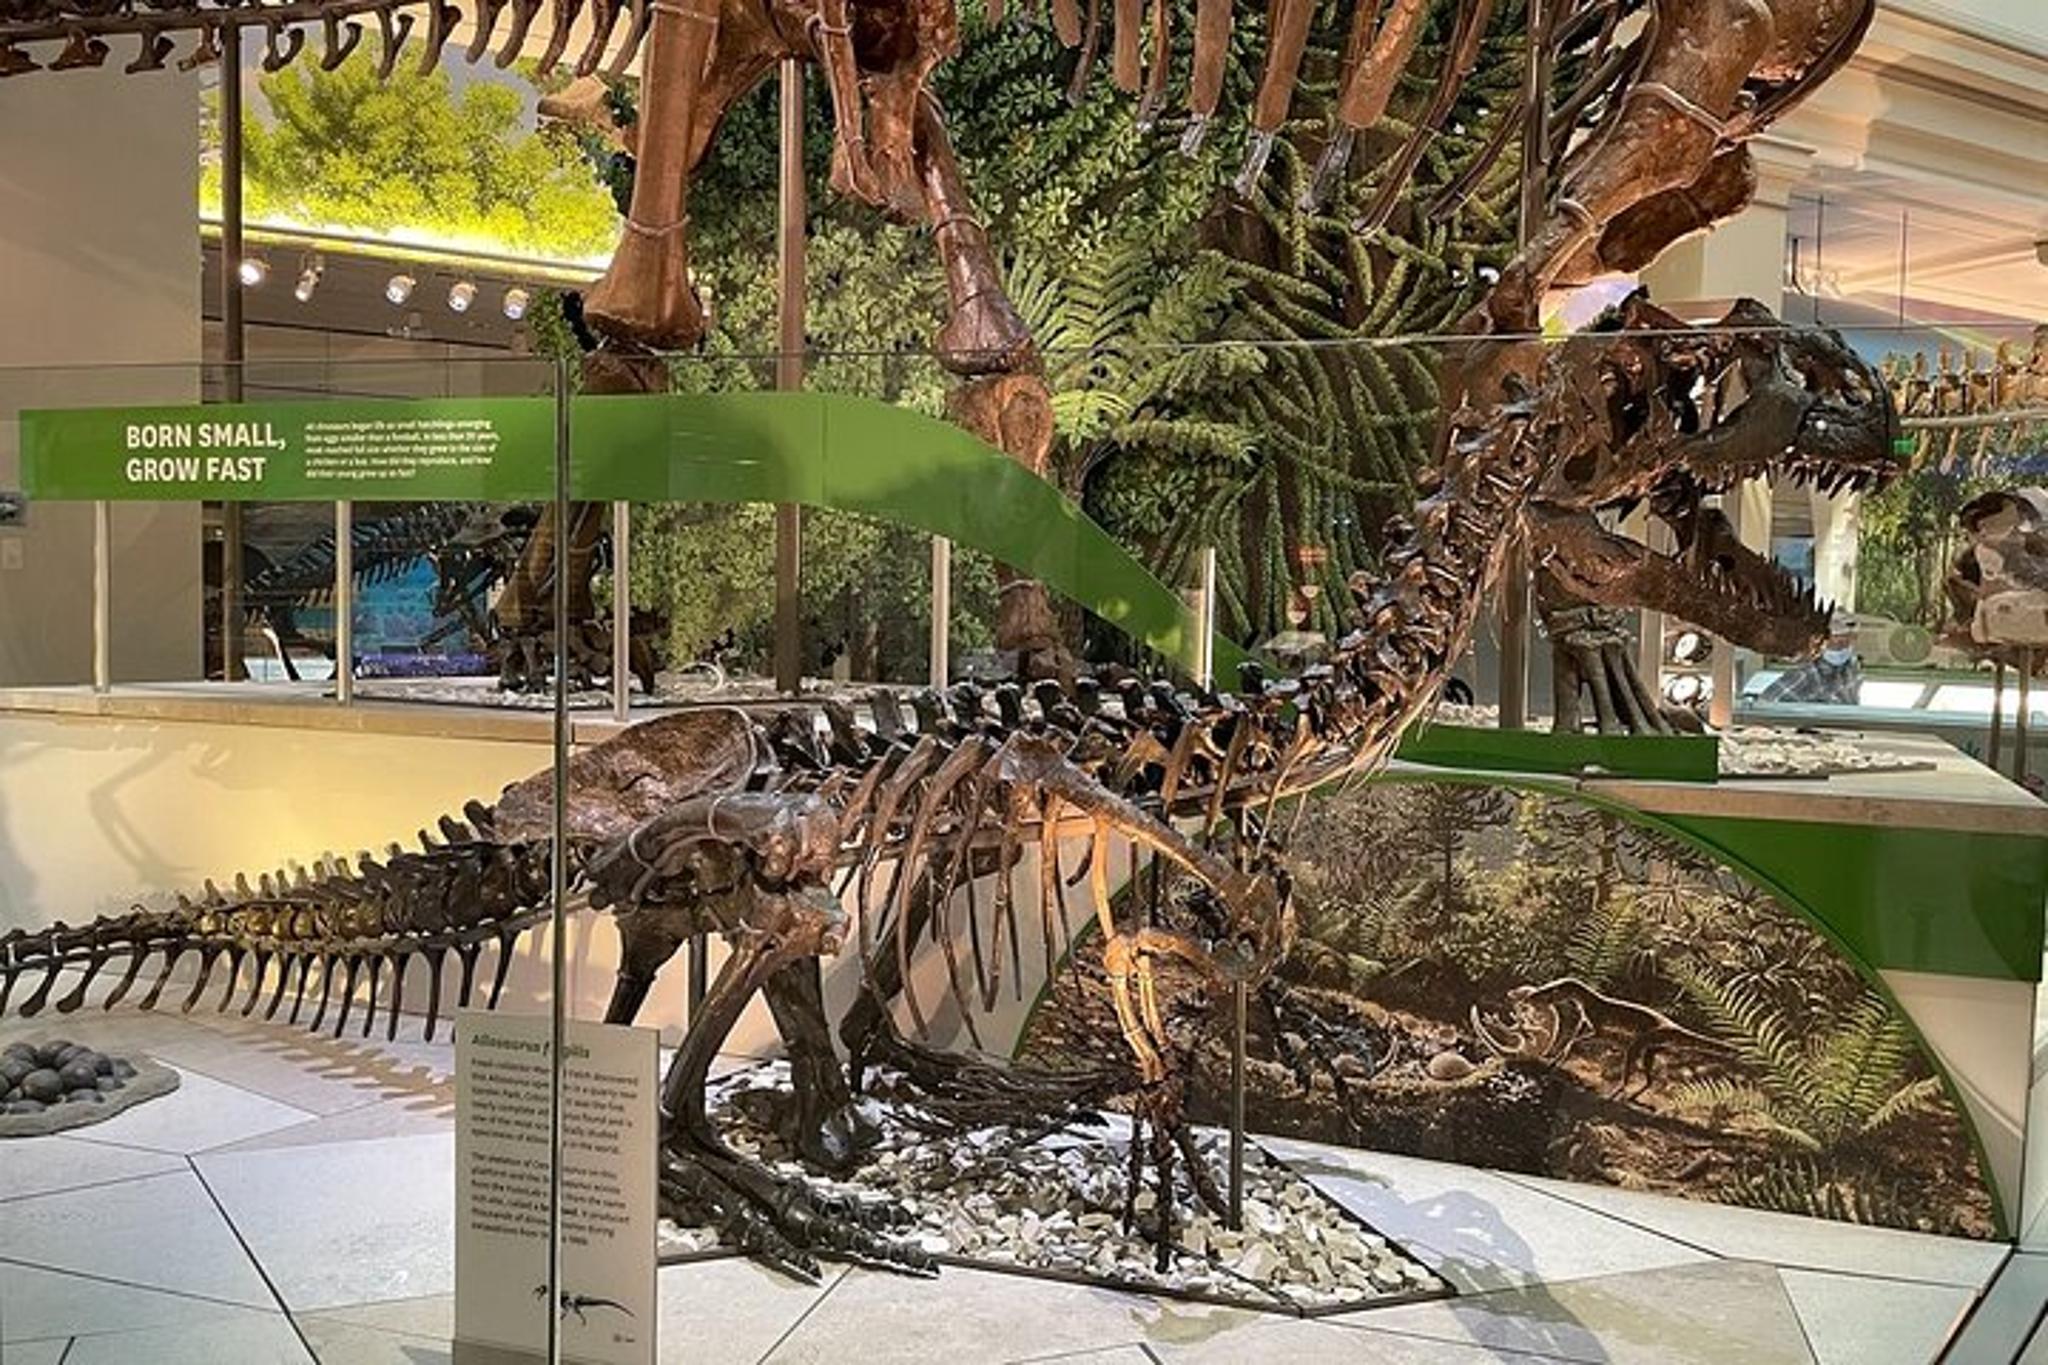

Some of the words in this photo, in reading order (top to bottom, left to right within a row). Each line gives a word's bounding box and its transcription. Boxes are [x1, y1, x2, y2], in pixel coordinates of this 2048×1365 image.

[126, 423, 192, 449] BORN
[198, 422, 286, 451] SMALL,
[126, 457, 200, 482] GROW
[206, 457, 266, 482] FAST
[472, 1034, 541, 1052] Allosaurus
